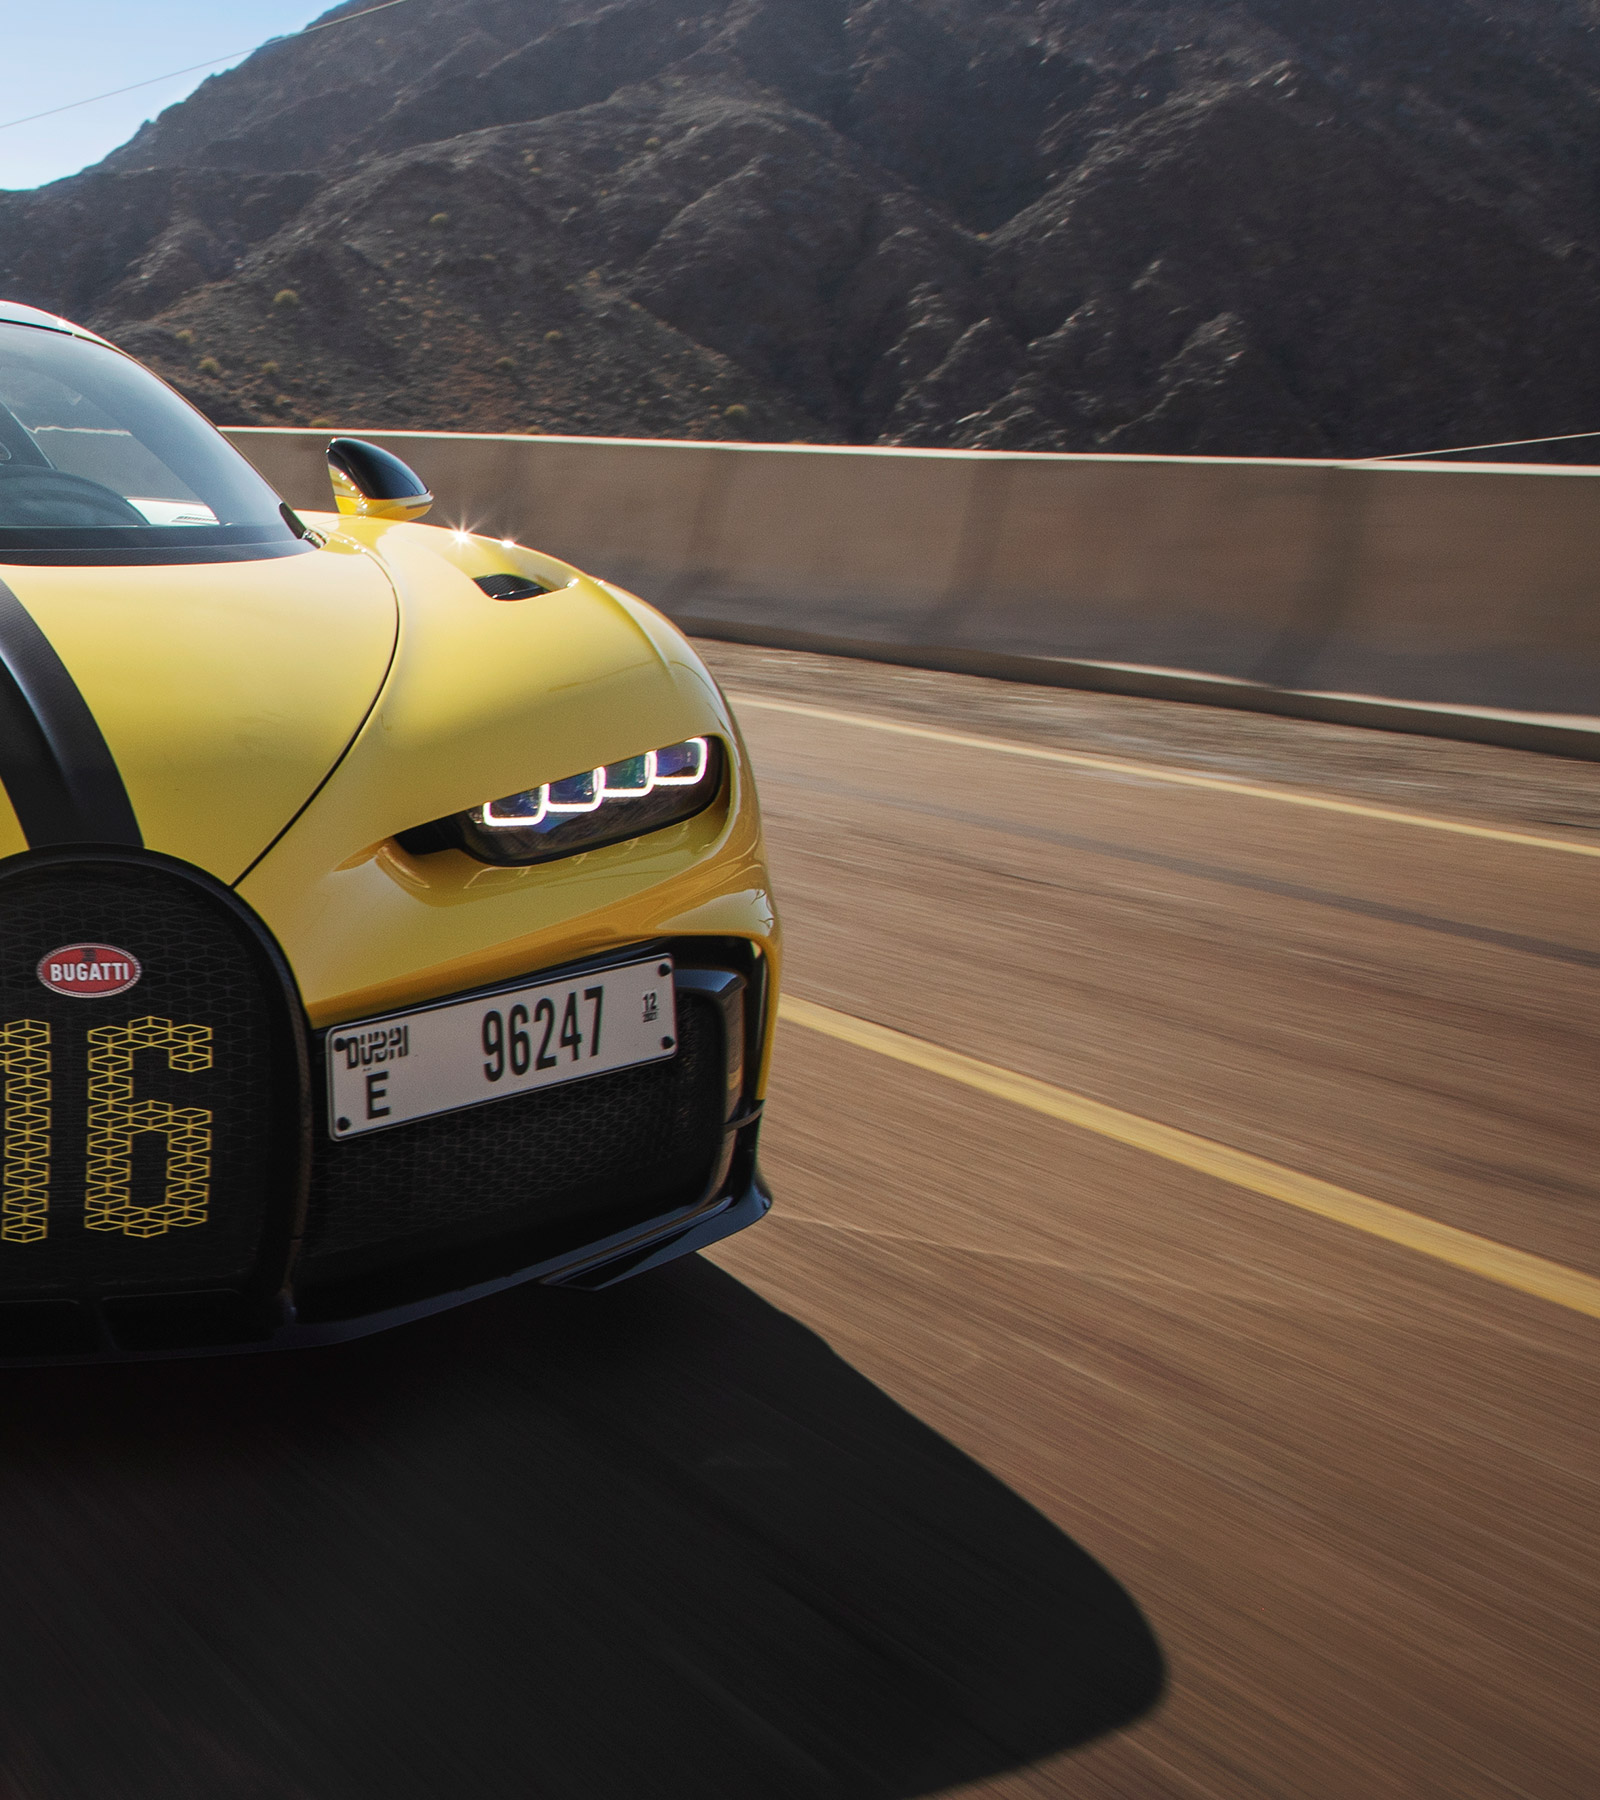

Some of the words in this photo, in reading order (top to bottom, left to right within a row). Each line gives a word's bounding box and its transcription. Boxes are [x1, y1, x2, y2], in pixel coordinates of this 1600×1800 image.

[50, 962, 130, 982] BUGATTI
[642, 992, 657, 1012] 12
[346, 1024, 409, 1070] DUBAI
[481, 985, 604, 1082] 96247
[365, 1070, 392, 1120] E
